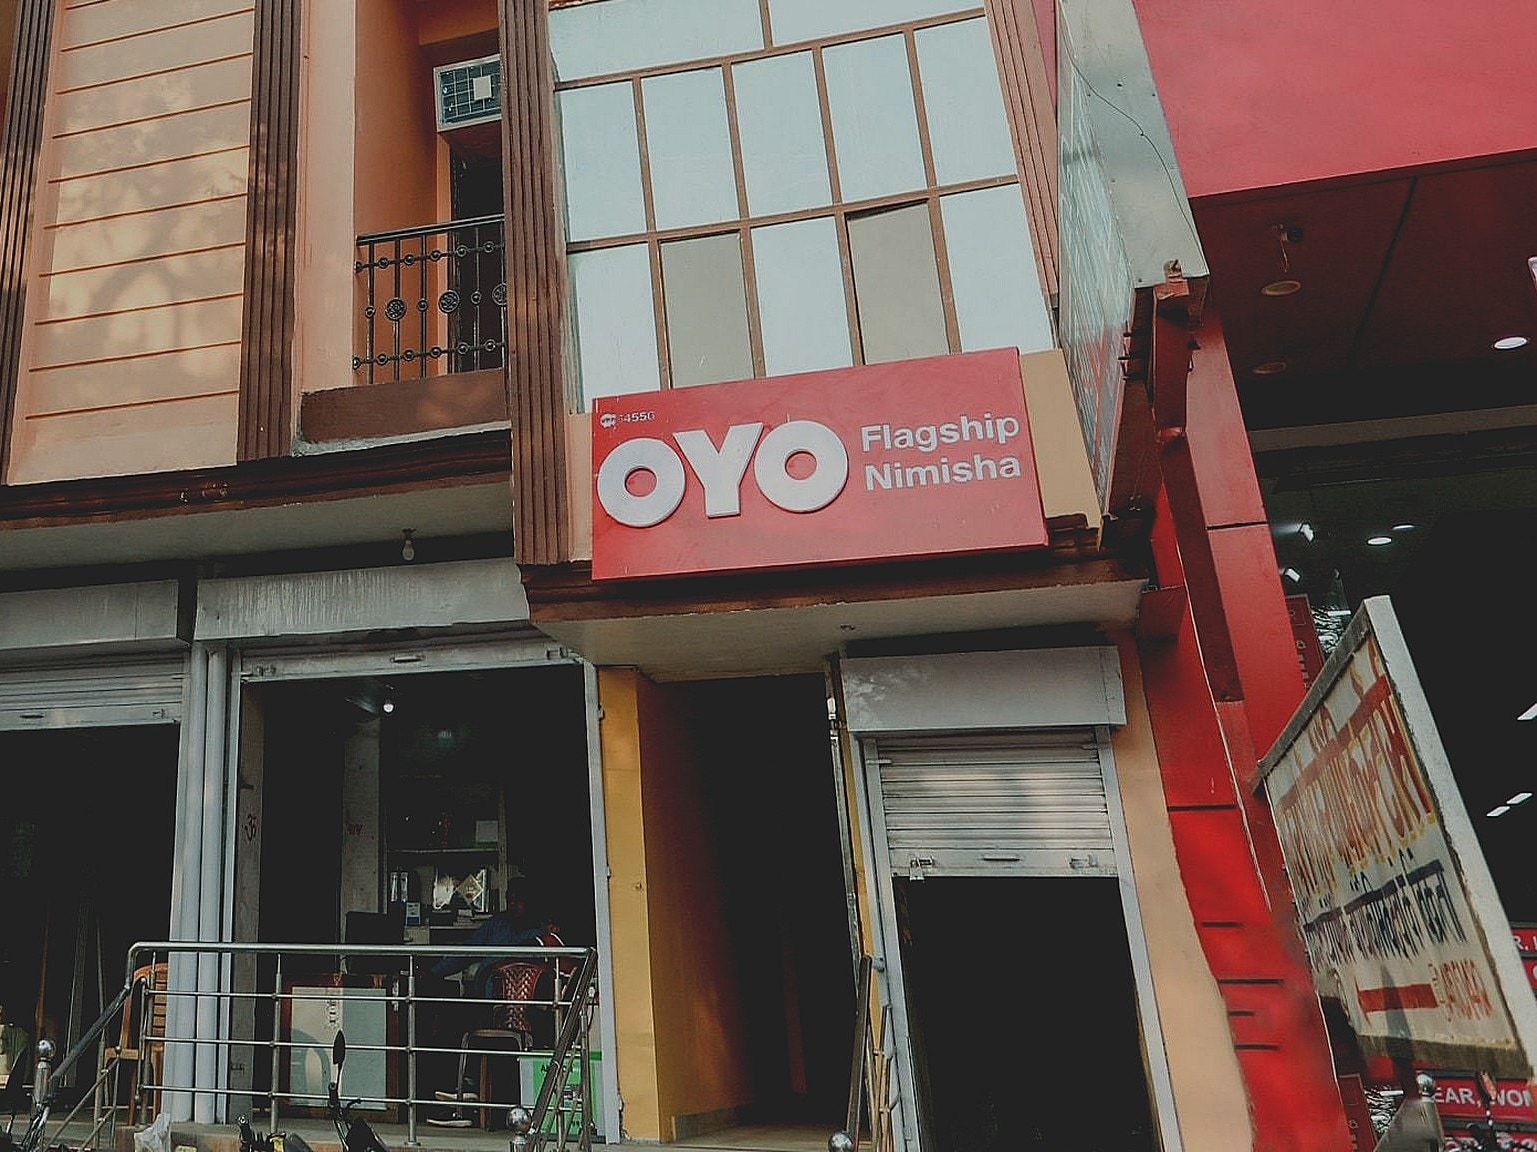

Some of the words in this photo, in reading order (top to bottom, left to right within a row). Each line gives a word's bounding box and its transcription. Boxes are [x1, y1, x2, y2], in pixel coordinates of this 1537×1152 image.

[860, 411, 1020, 453] Flagship
[597, 419, 849, 529] OYO
[865, 453, 1021, 491] Nimisha
